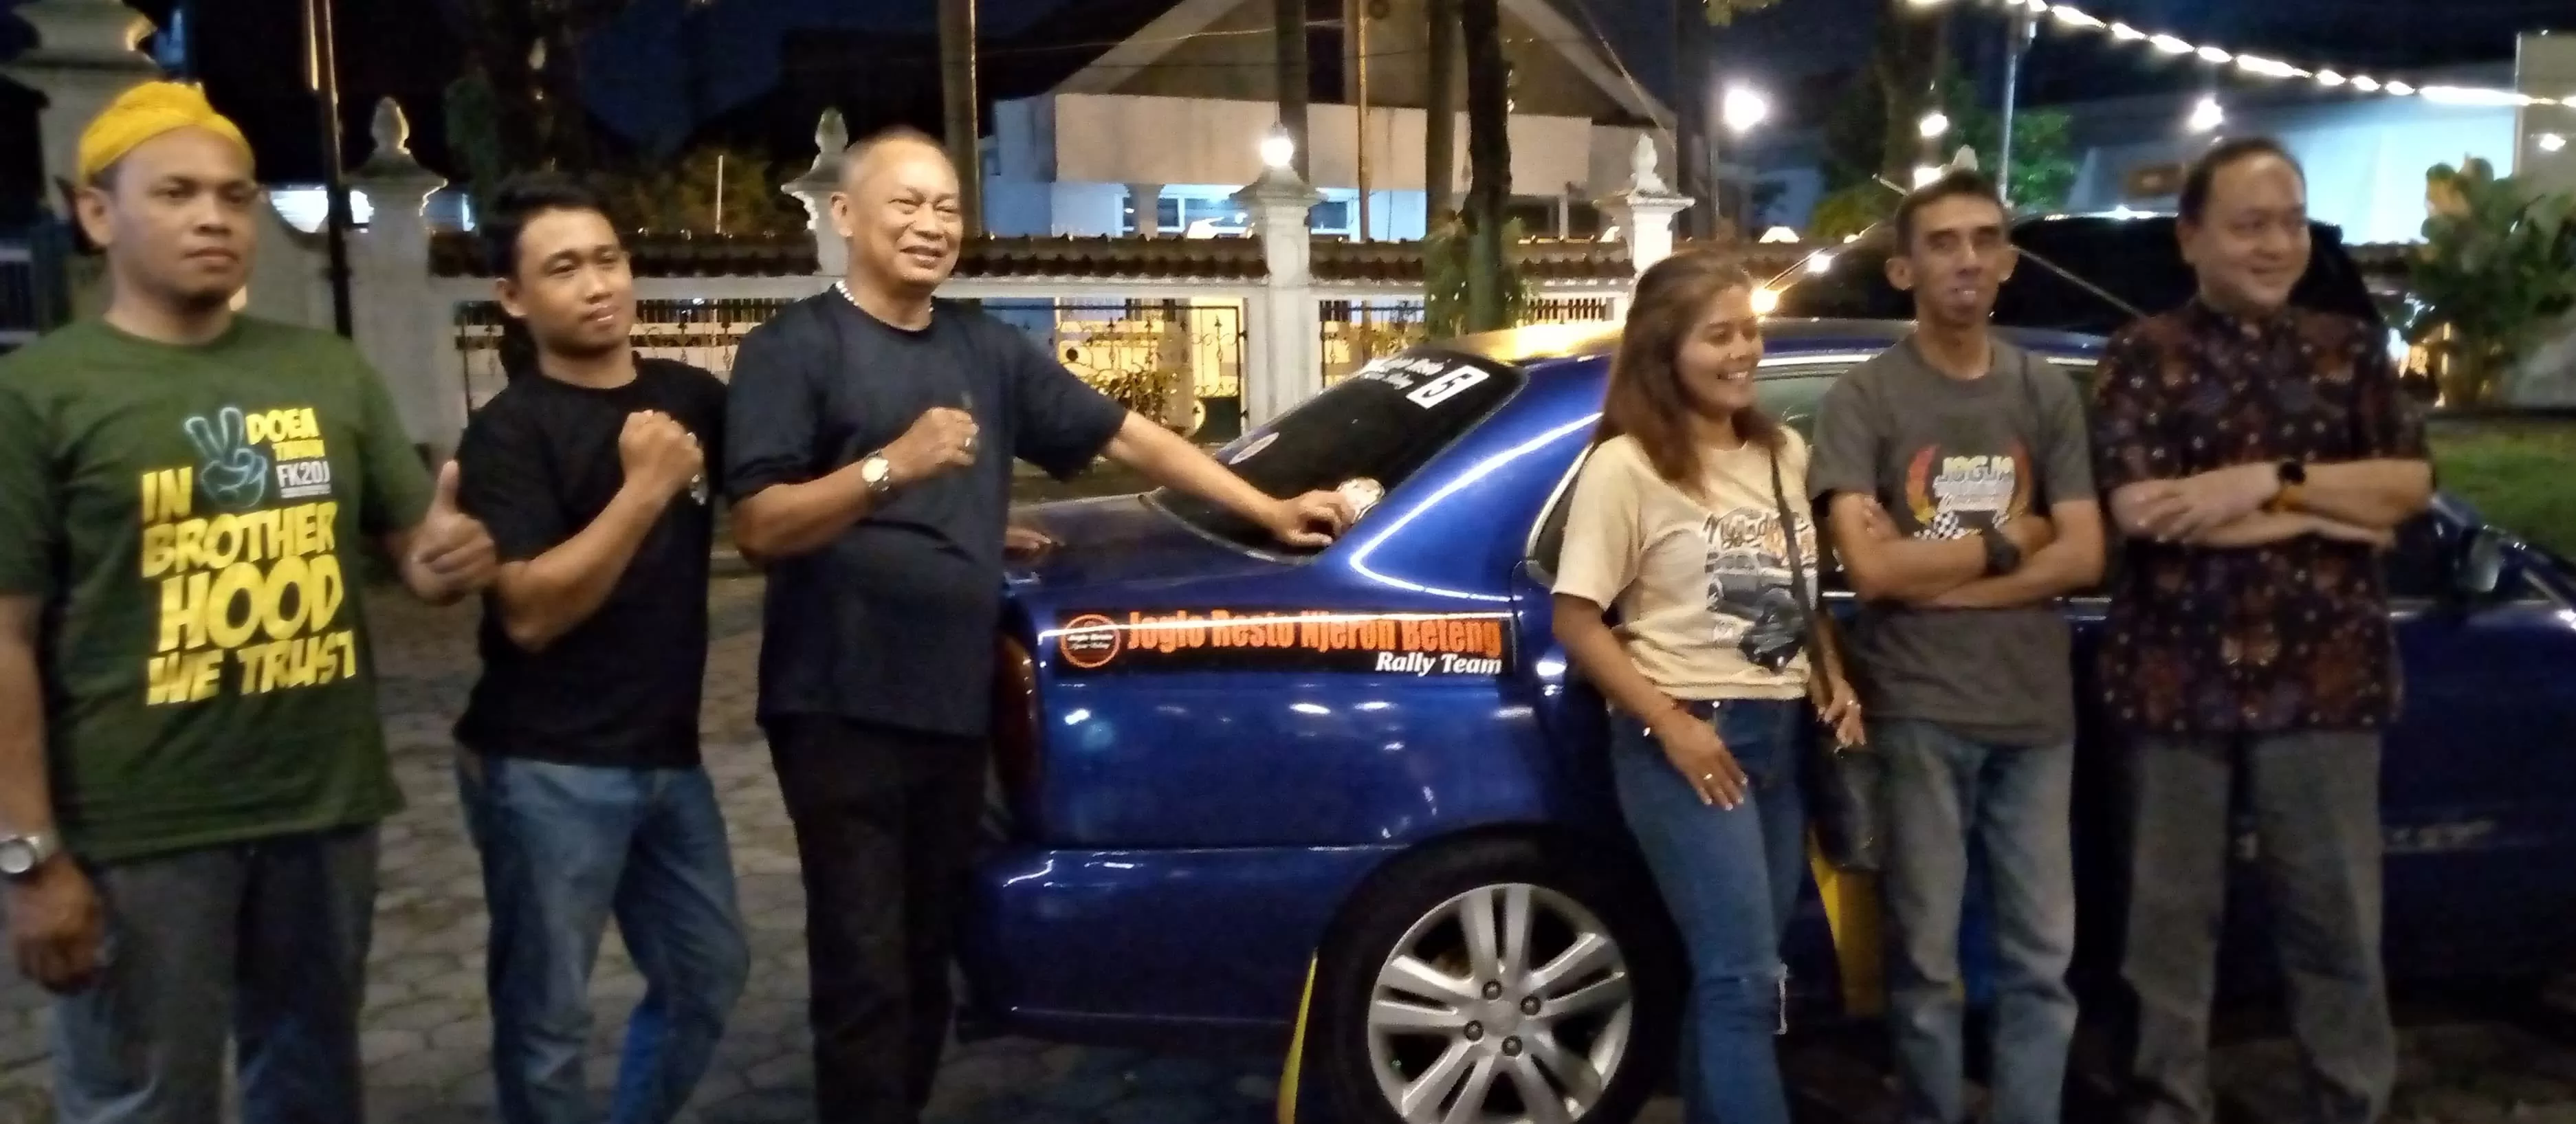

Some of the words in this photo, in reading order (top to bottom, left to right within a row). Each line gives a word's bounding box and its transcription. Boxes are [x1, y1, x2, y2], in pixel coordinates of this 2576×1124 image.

[142, 466, 193, 524] IN
[142, 501, 338, 578] BROTHER
[158, 554, 343, 652] HOOD
[1127, 609, 1205, 654] Joglo
[1211, 608, 1295, 649] Resto
[146, 649, 224, 706] WE
[236, 630, 357, 696] TRUST
[1375, 651, 1437, 677] Rally
[1441, 653, 1502, 675] Team
